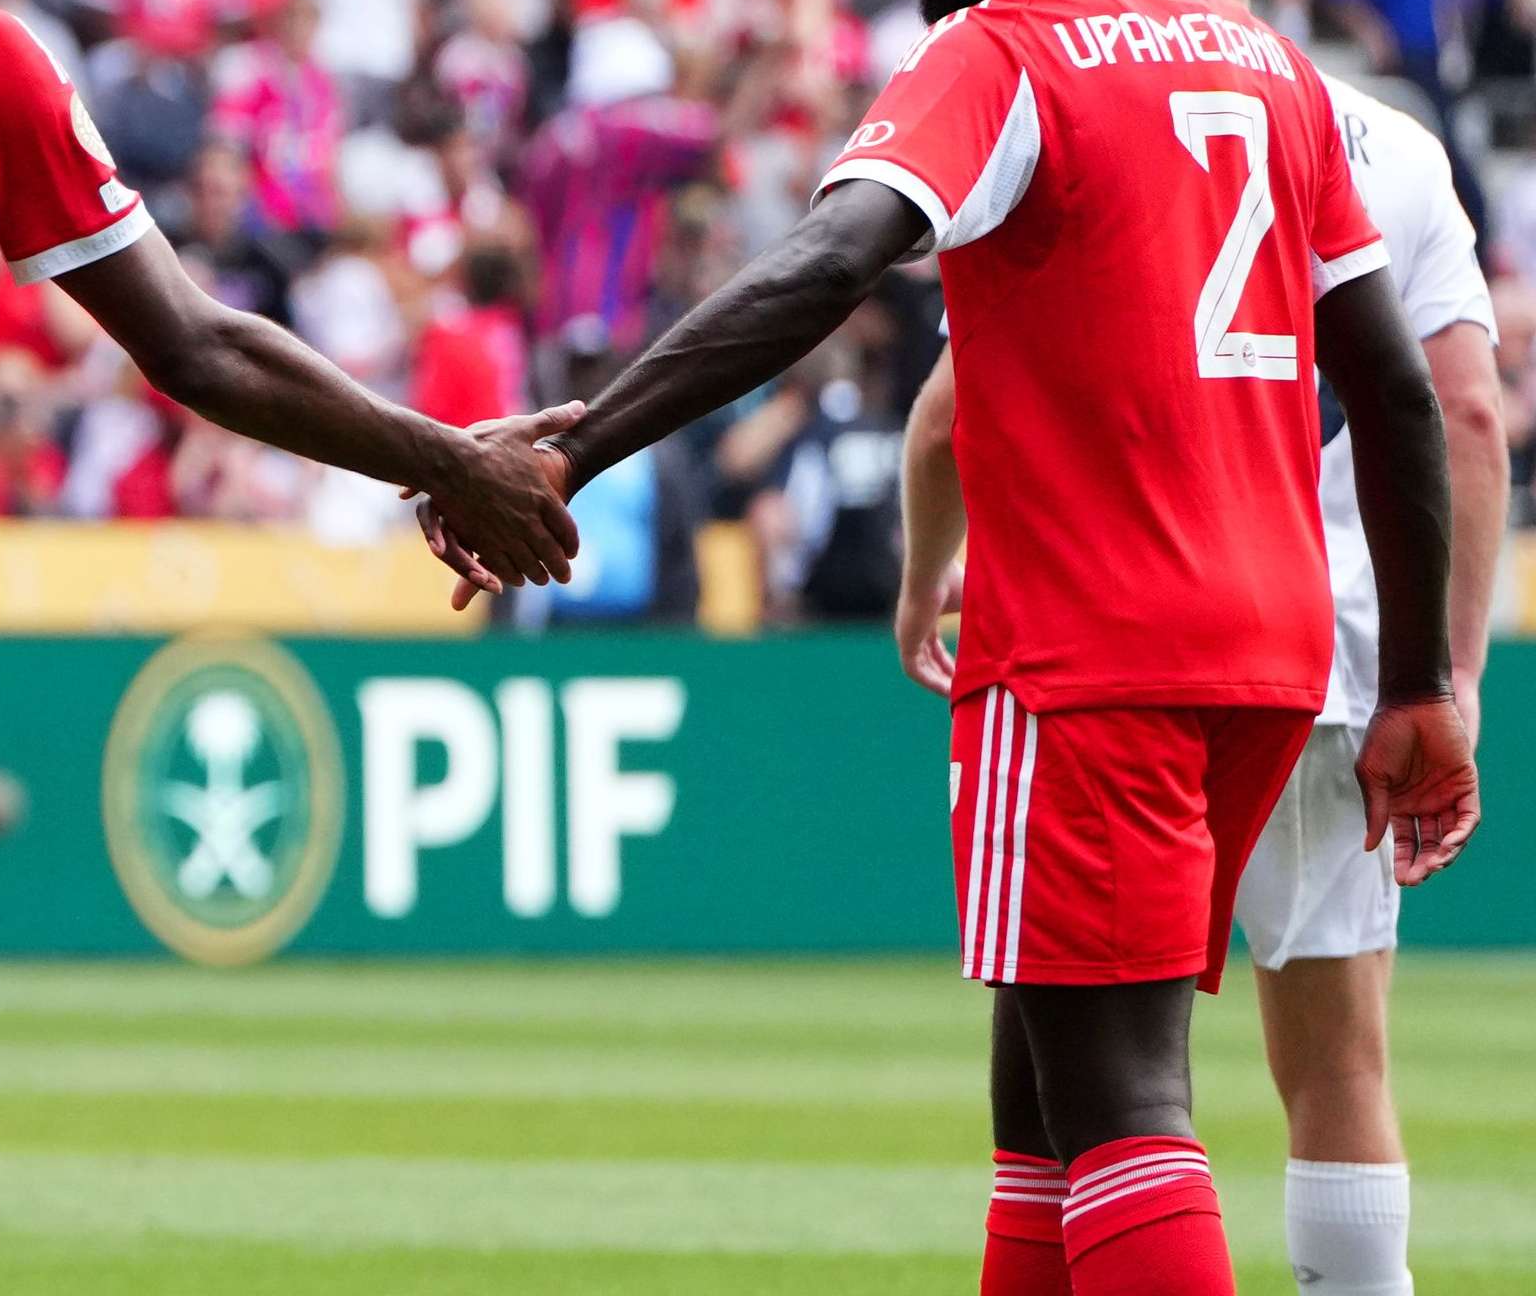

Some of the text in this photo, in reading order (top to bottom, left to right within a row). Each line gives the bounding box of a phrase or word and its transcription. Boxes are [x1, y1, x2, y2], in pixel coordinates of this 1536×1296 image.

[1053, 12, 1296, 82] UPAMECANO
[1169, 90, 1297, 381] 2
[356, 675, 687, 919] PIF
